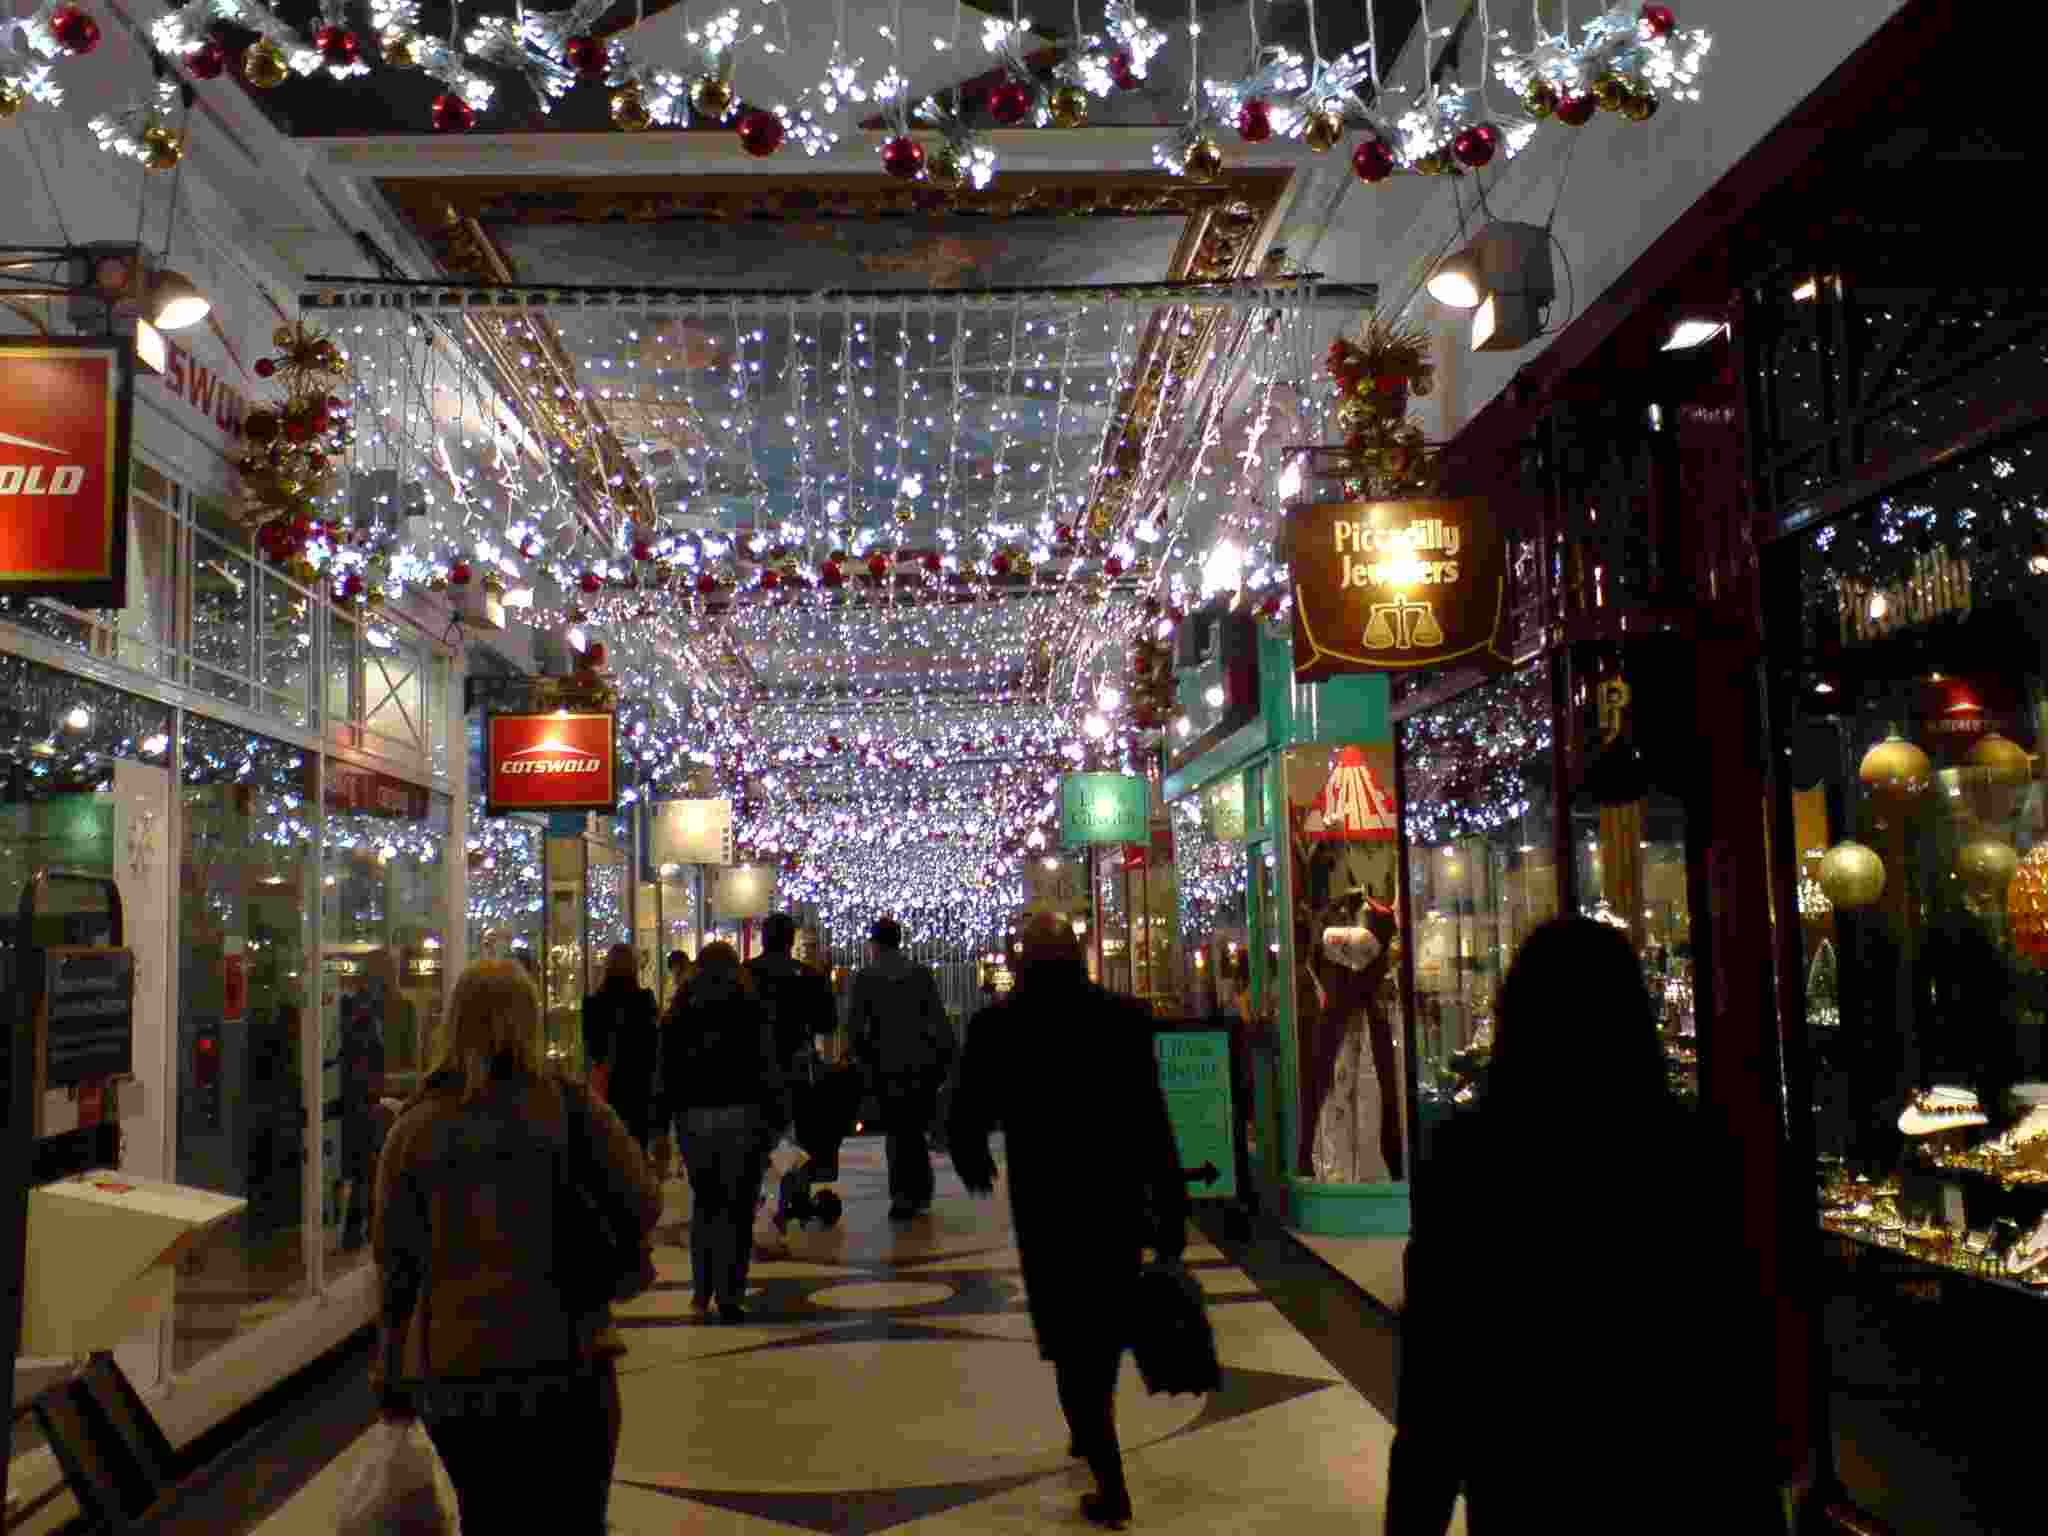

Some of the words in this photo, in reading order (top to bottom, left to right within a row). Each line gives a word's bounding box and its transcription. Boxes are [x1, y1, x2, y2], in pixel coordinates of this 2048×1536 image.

[0, 465, 85, 495] OLD
[1333, 519, 1460, 554] Picdilly
[1341, 555, 1459, 588] Jewers
[501, 759, 601, 775] COTSWOLD
